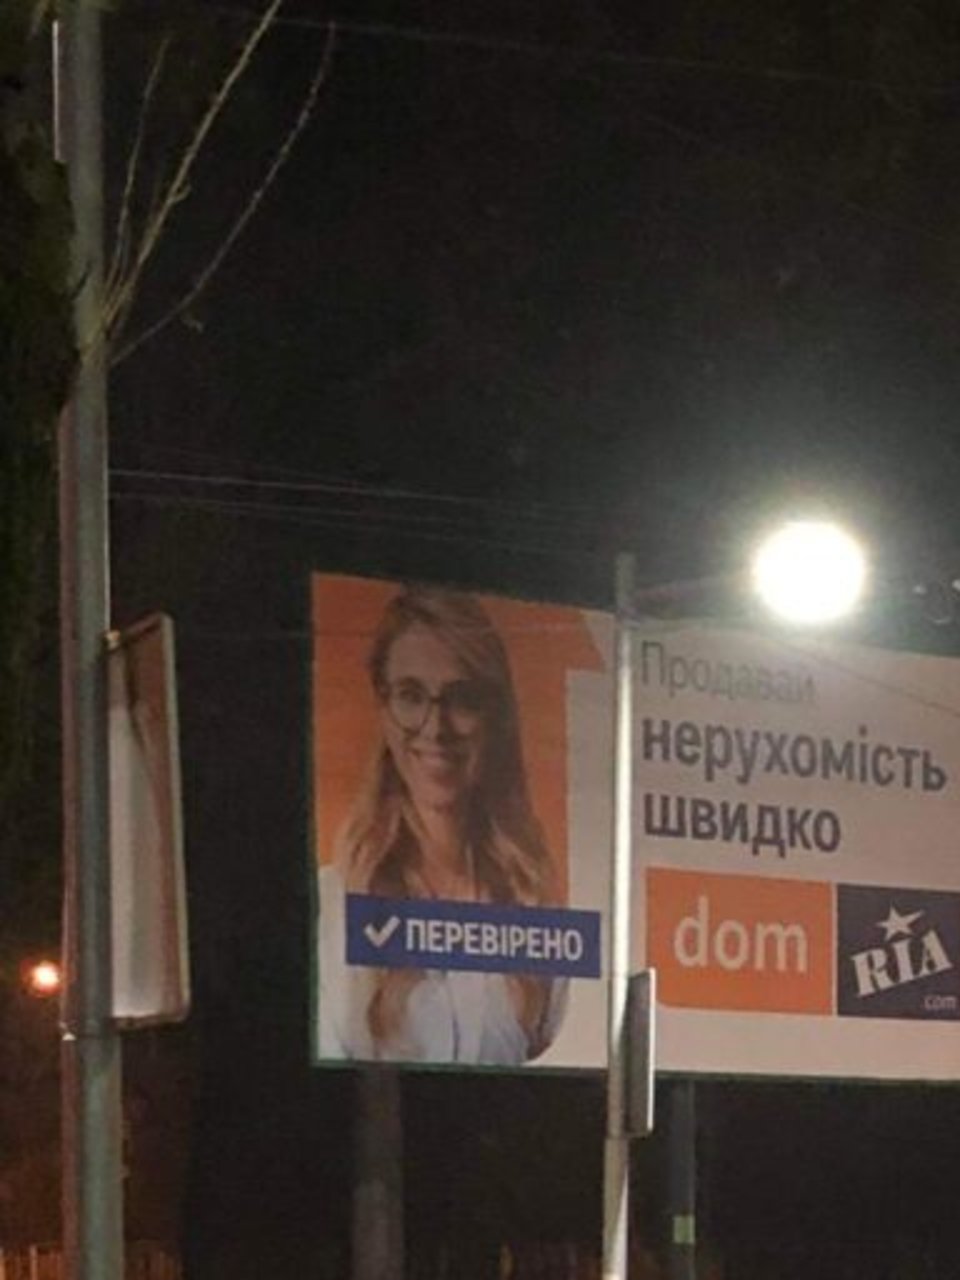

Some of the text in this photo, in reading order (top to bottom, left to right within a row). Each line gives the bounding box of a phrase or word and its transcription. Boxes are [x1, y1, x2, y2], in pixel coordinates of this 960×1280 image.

[642, 717, 947, 792] нерухомість
[643, 793, 841, 858] швидко
[405, 918, 584, 961] ПЕРЕВІРЕНО
[673, 895, 808, 974] dom
[850, 929, 954, 998] RIA
